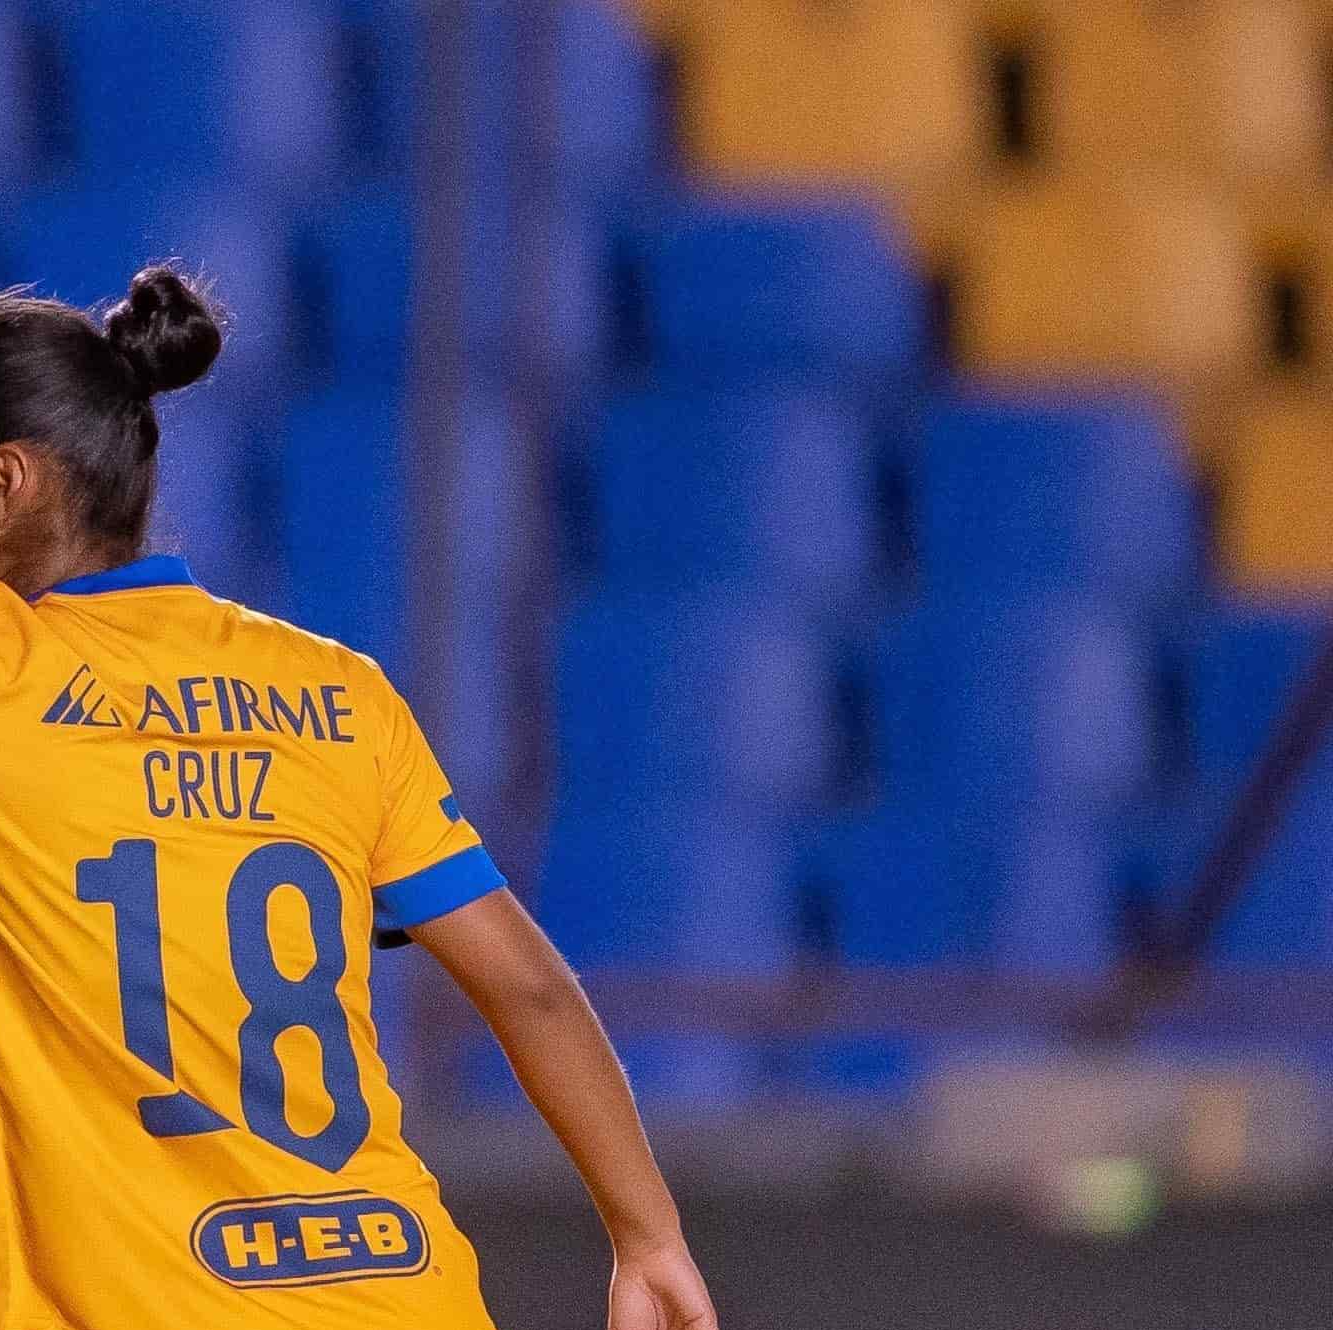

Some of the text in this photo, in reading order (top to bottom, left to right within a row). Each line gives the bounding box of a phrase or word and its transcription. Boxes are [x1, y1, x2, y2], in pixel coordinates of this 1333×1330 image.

[136, 677, 355, 743] AFIRME
[143, 750, 276, 822] CRUZ
[75, 838, 371, 1174] 18
